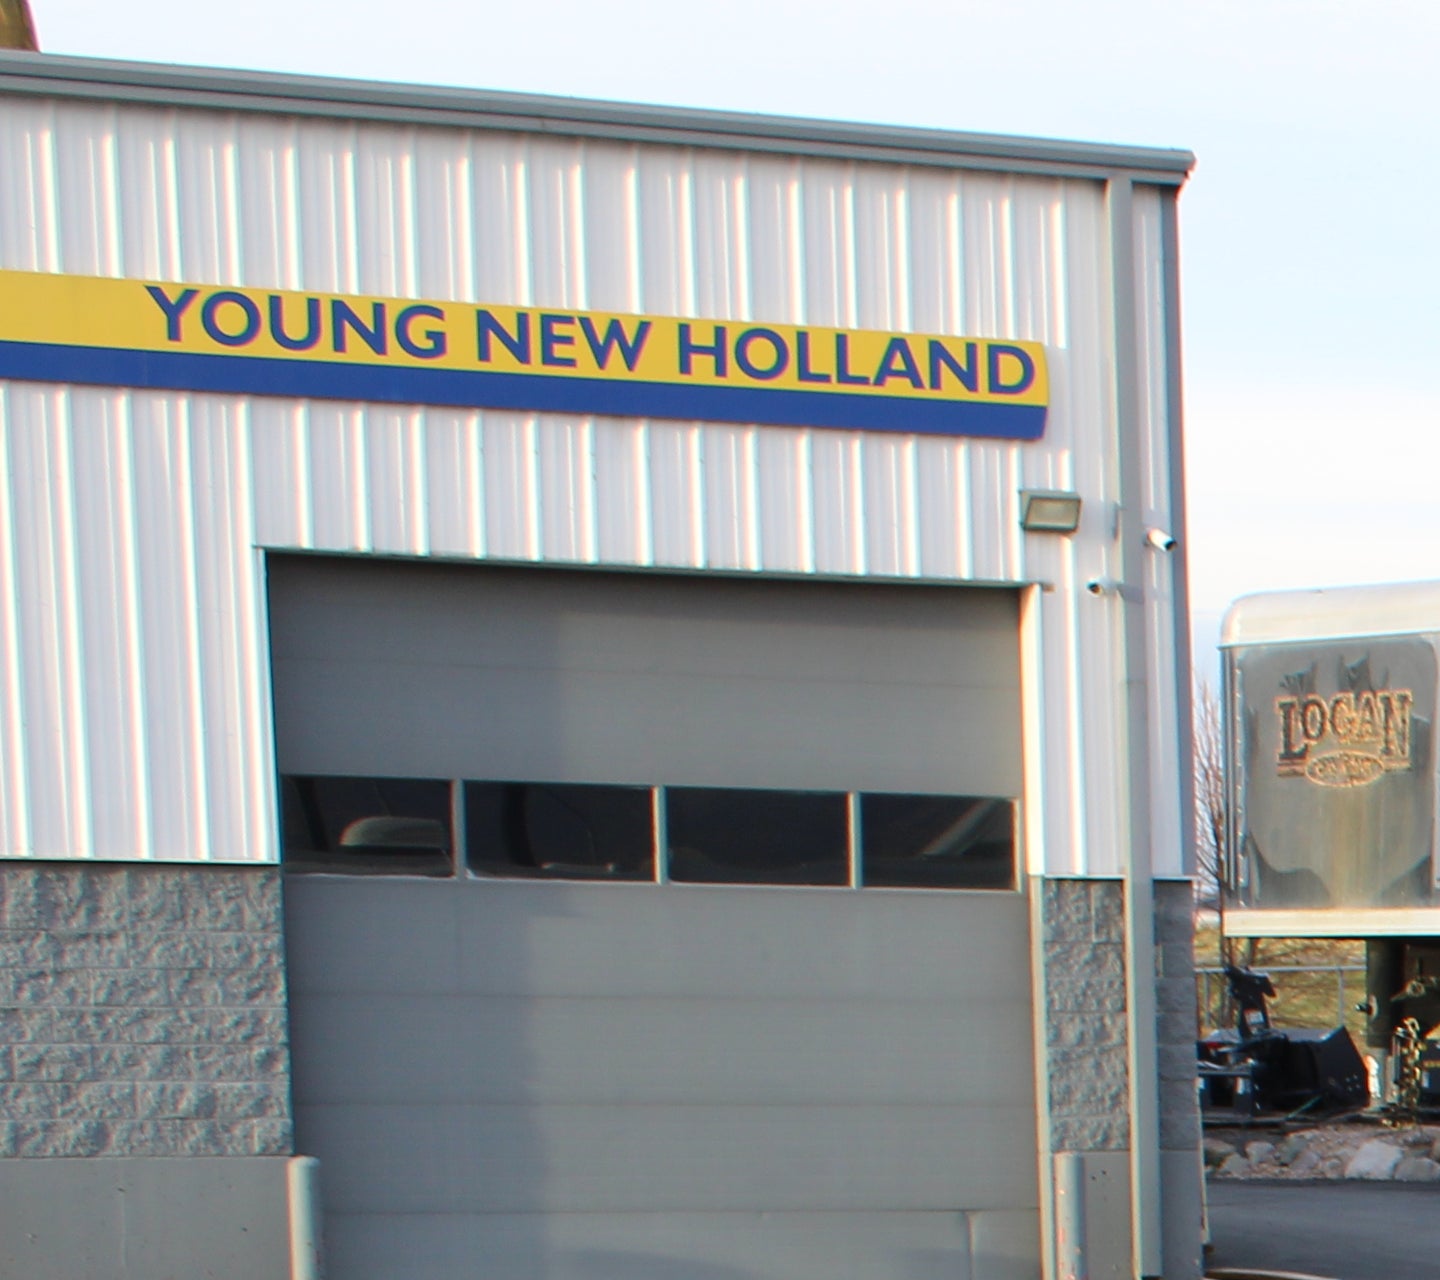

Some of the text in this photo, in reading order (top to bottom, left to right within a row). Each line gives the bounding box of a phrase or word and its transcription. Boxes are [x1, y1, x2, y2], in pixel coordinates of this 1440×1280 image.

[145, 286, 1036, 395] YOUNG NEW HOLLAND
[1276, 690, 1413, 760] LOGAN
